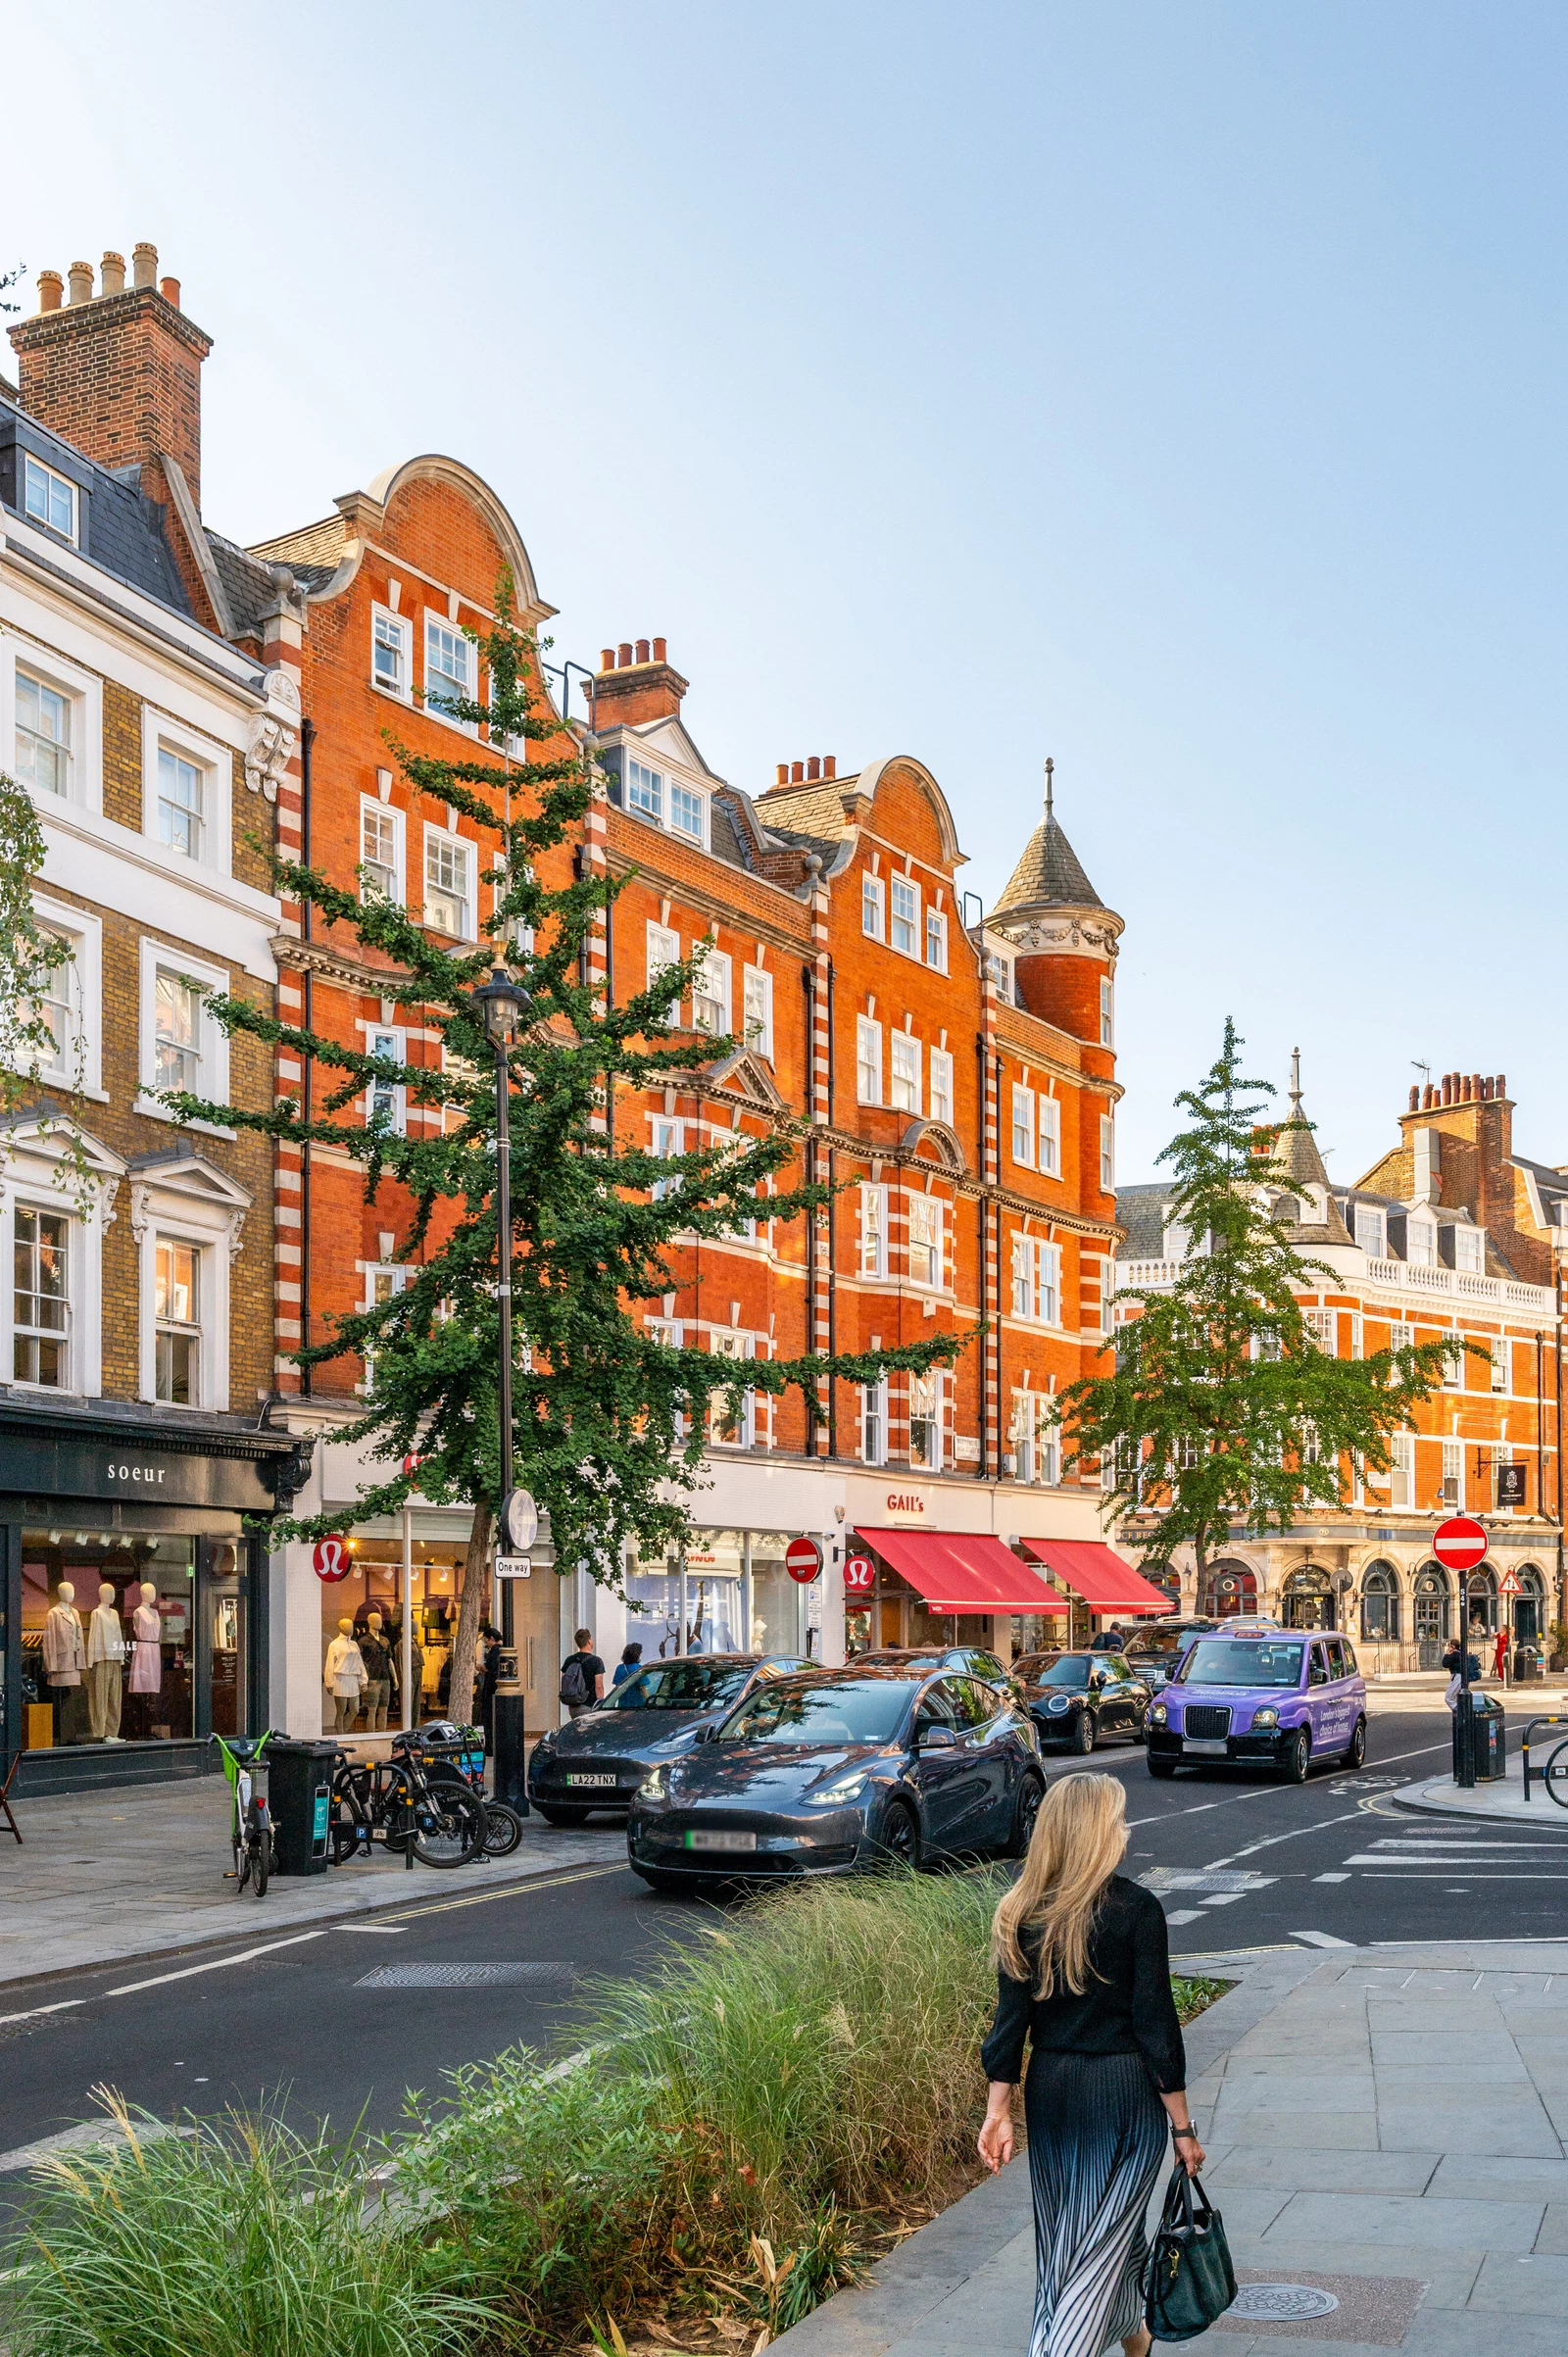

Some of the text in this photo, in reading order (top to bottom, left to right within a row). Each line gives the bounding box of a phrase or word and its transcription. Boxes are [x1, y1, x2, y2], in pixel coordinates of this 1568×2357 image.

[108, 1464, 166, 1483] soeur
[887, 1494, 924, 1512] GAIL's
[498, 1561, 528, 1574] One way
[112, 1641, 138, 1651] SALE
[571, 1775, 614, 1785] LA22 TNX
